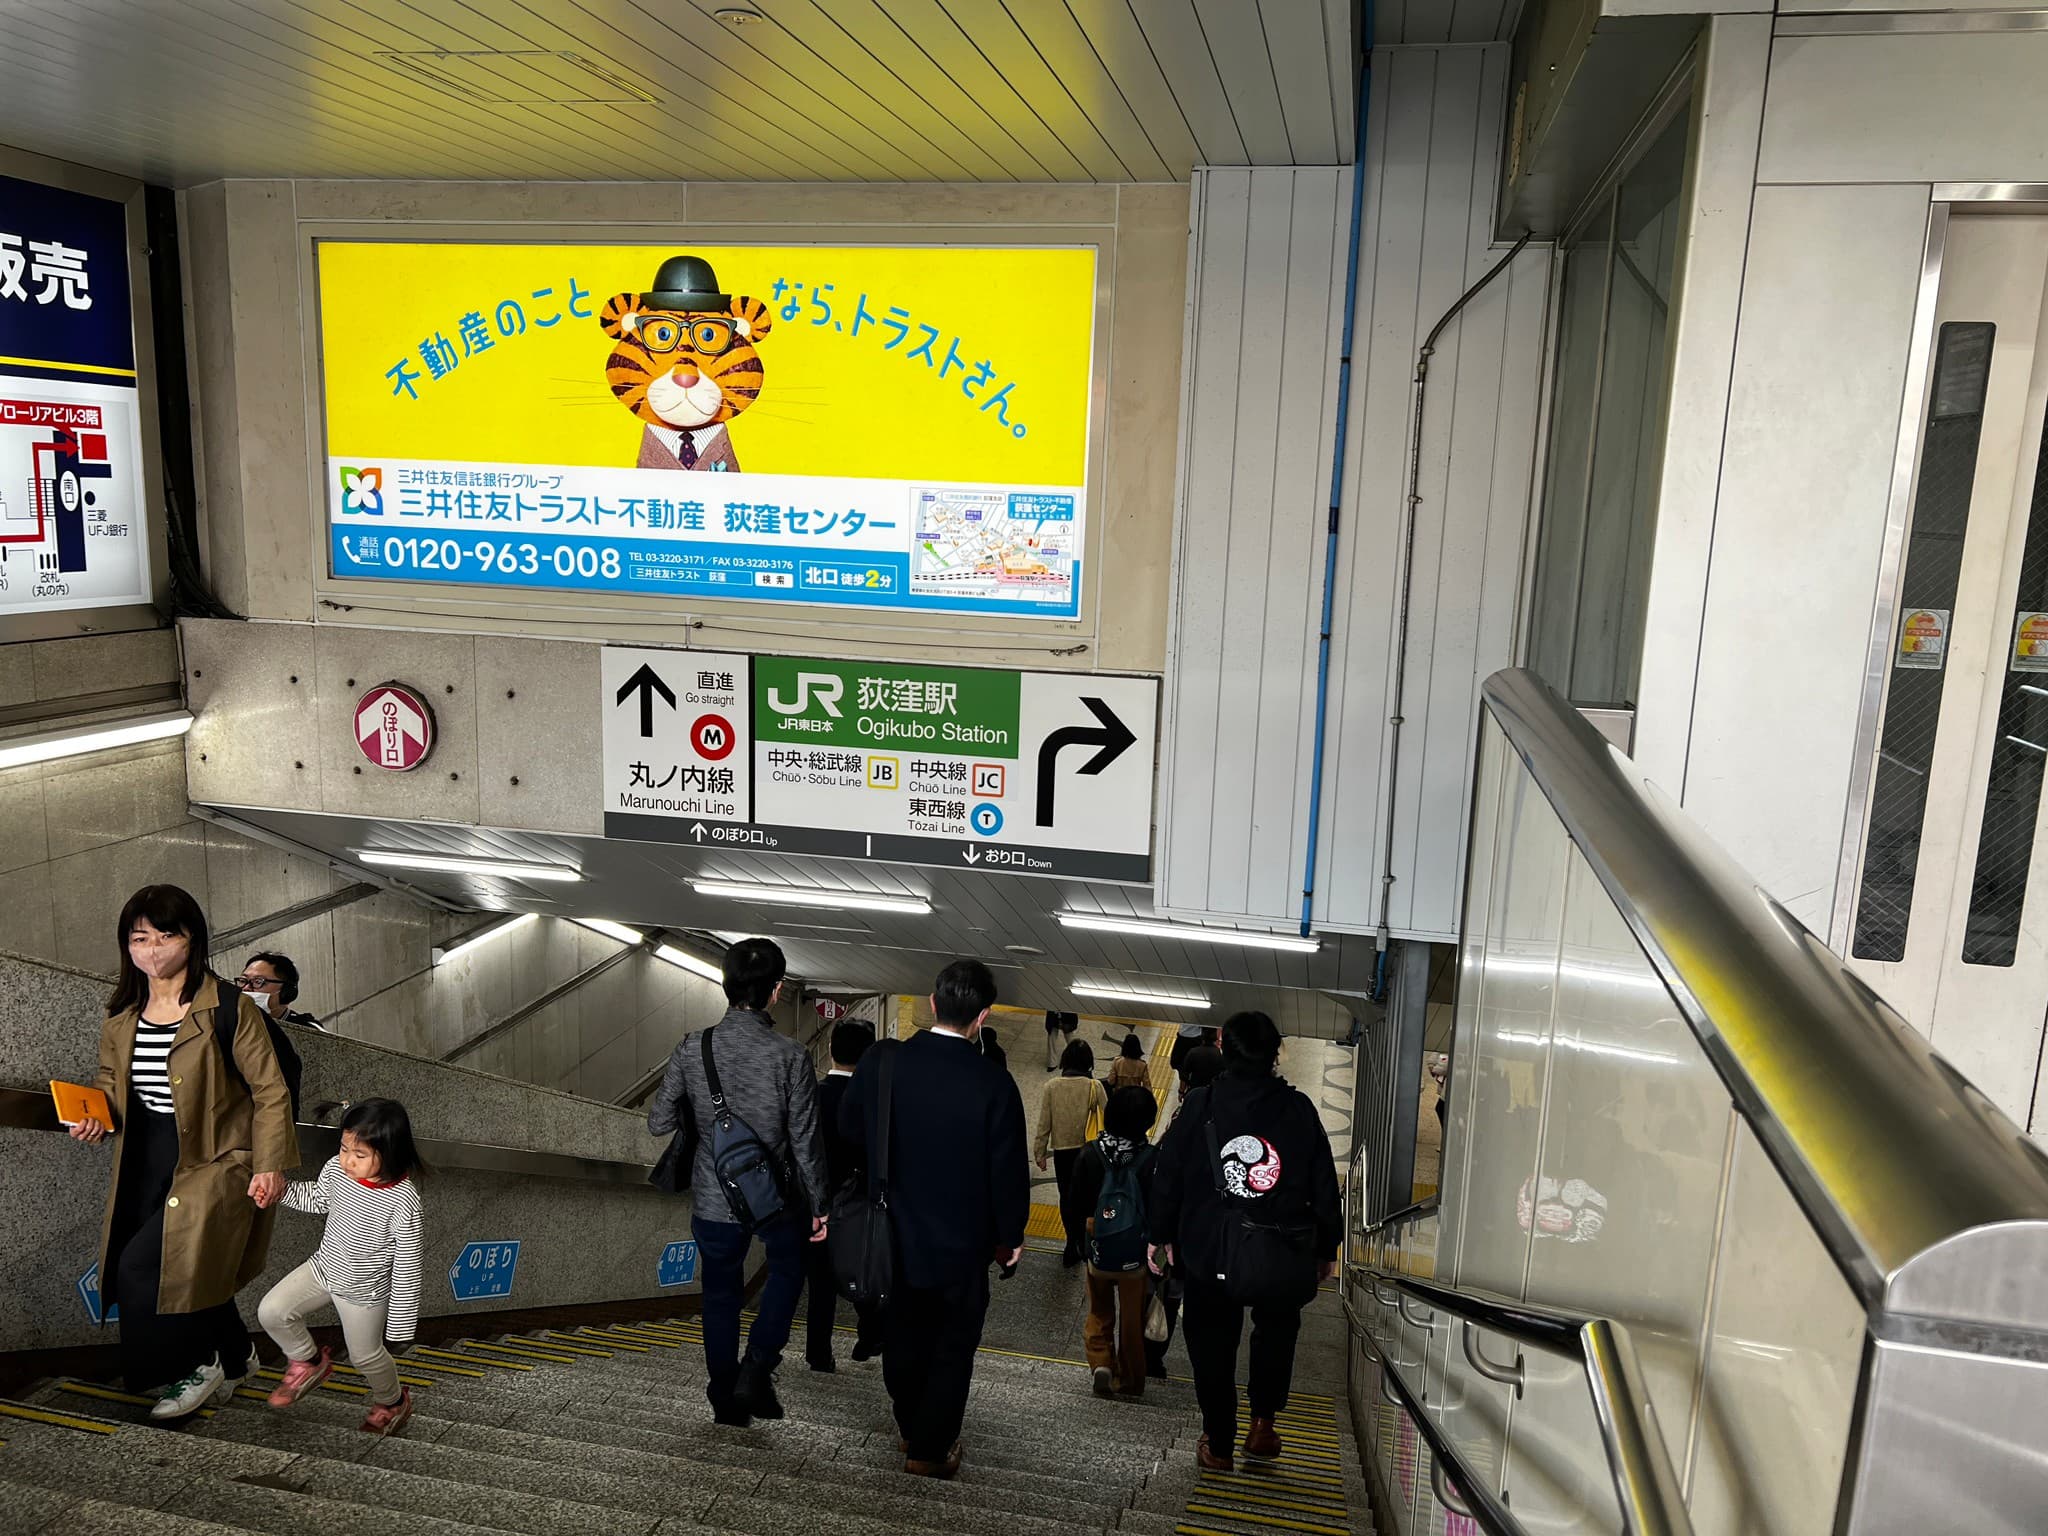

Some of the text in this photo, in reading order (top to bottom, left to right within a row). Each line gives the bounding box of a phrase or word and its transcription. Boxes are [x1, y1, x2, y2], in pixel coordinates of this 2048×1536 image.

[385, 277, 593, 400] 不動産のこと
[771, 277, 1027, 439] なら、トラストさん。
[398, 469, 564, 490] 三井住友信託銀行グループ
[63, 479, 75, 503] 南口
[88, 509, 107, 522] 三菱
[400, 489, 896, 537] 三井住友トラスト不動産 荻窪センター
[88, 524, 128, 537] UFJ銀行
[384, 536, 621, 580] 0120-963-008
[629, 551, 645, 562] TEL
[733, 557, 793, 570] 03-3220-3176
[40, 572, 60, 584] 改札
[635, 568, 700, 580] 三井住友トラスト
[805, 566, 892, 589] 北口 徒歩2分
[32, 583, 70, 597] (丸の内)
[697, 671, 735, 691] 直進
[685, 692, 735, 707] Go straight
[767, 672, 844, 718] JR
[857, 677, 958, 716] 荻窪駅
[382, 702, 400, 762] のぼり口
[778, 718, 834, 733] JR東日本
[857, 716, 1008, 744] Ogikubo Station
[703, 729, 722, 745] M
[768, 749, 863, 773] 中央・総武線
[910, 759, 967, 782] 中央線
[629, 761, 735, 794] 丸ノ内線
[839, 775, 862, 788] Line
[872, 765, 893, 781] JB
[977, 772, 999, 789] JC
[942, 784, 967, 796] Line
[620, 793, 735, 815] Marunouchi Line
[909, 799, 966, 820] 東西線
[941, 822, 965, 834] Line
[983, 814, 991, 825] T
[712, 827, 778, 848] のぼり口 Up
[985, 849, 1052, 869] おり口 Down
[469, 1246, 512, 1269] のぼり
[668, 1244, 694, 1263] のぼり
